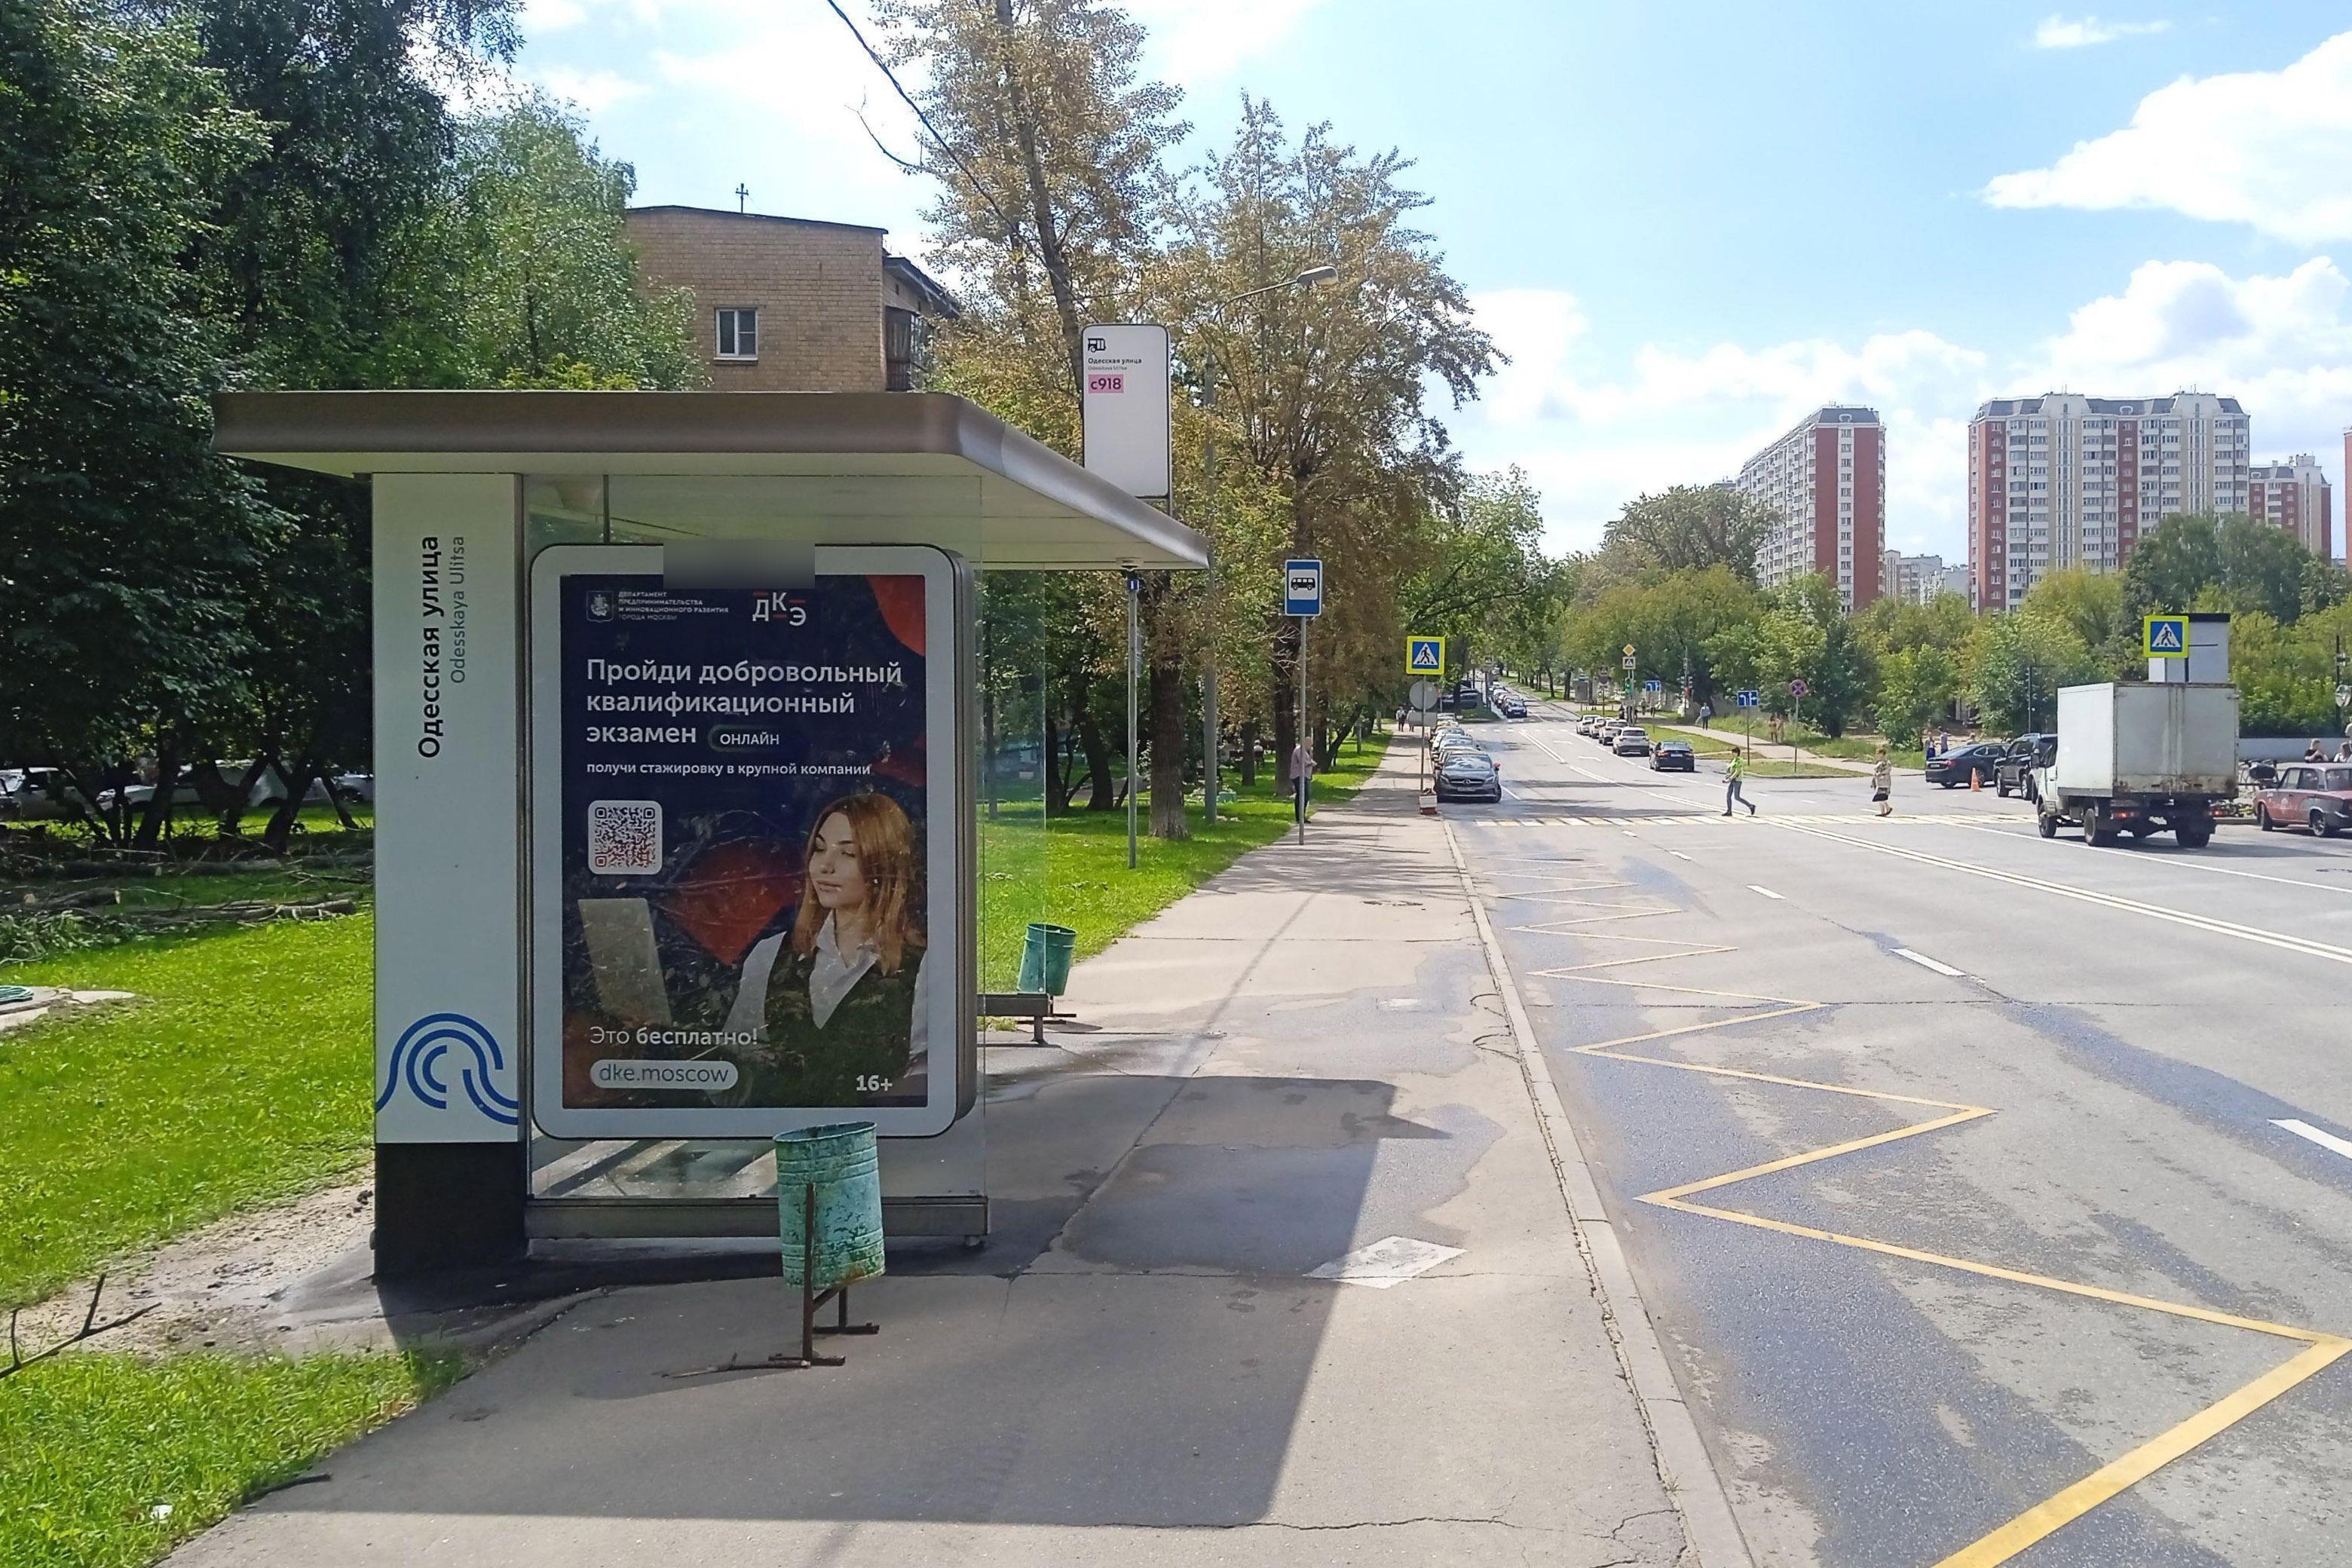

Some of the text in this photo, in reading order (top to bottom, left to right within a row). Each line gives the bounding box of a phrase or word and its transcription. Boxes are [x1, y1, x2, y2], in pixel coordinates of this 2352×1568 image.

[449, 536, 467, 684] Odesskaya Ulitsa
[752, 592, 807, 626] ДКЭ
[418, 536, 444, 758] Одесская улица
[586, 658, 902, 687] Пройди добровольный
[586, 691, 855, 718] квалификационный
[586, 725, 780, 746] экзамен ОНЛАЙН
[586, 761, 871, 777] получи стажировку в крупной компании
[590, 1026, 758, 1046] Это бесплатно!
[599, 1063, 729, 1083] dke.moscow
[856, 1074, 893, 1092] 16+
